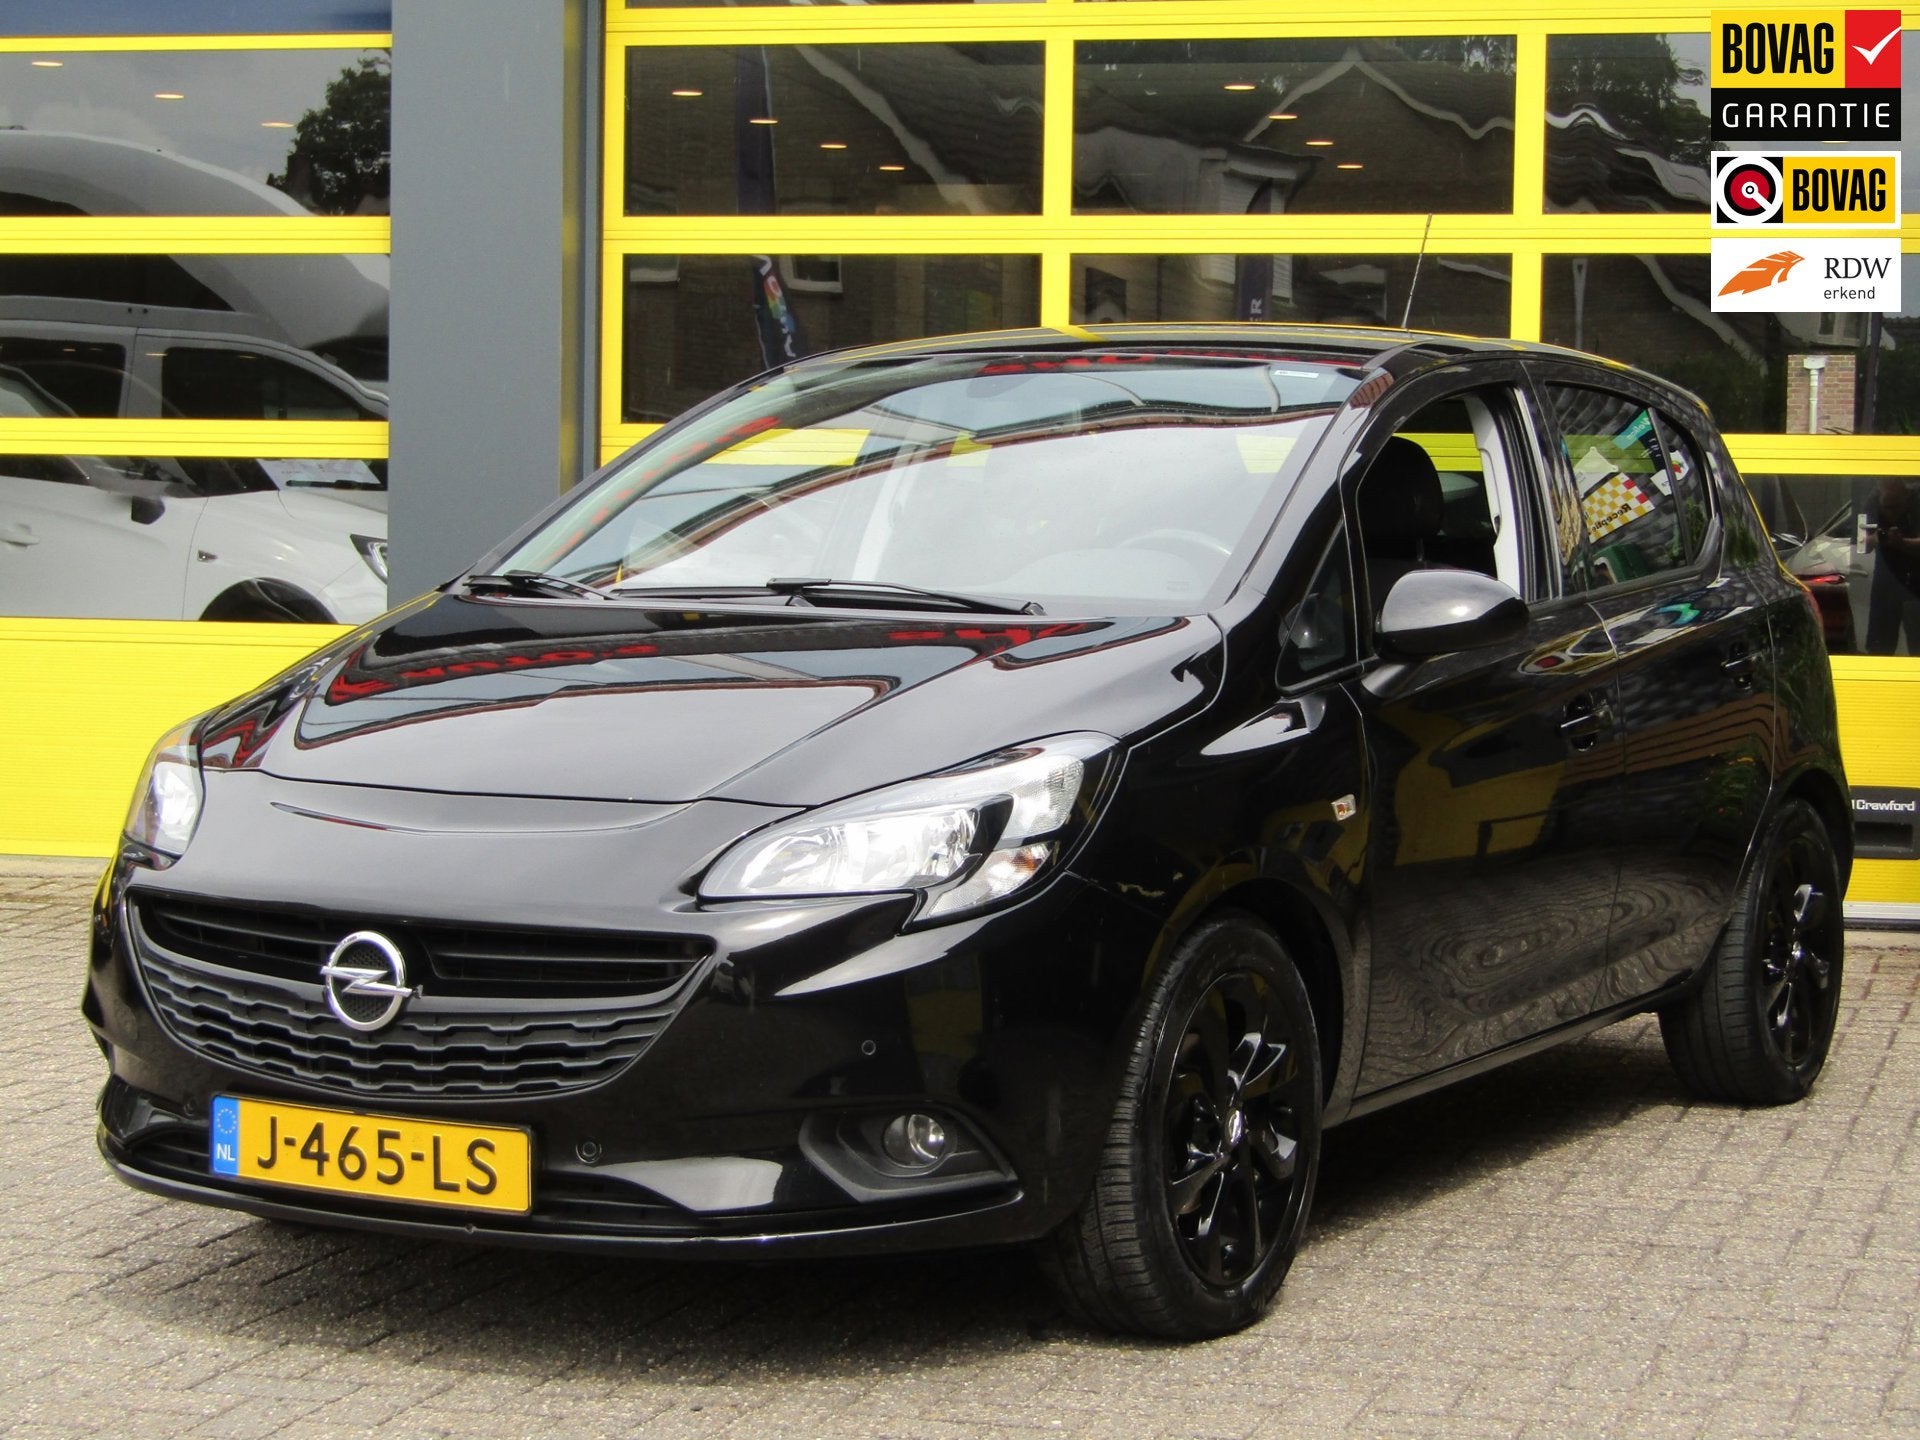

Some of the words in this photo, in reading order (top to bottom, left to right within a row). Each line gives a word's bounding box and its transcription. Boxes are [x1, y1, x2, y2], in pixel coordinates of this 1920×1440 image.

[1856, 799, 1916, 811] Crawford
[216, 1143, 236, 1162] NL
[257, 1115, 498, 1195] J-465-LS
